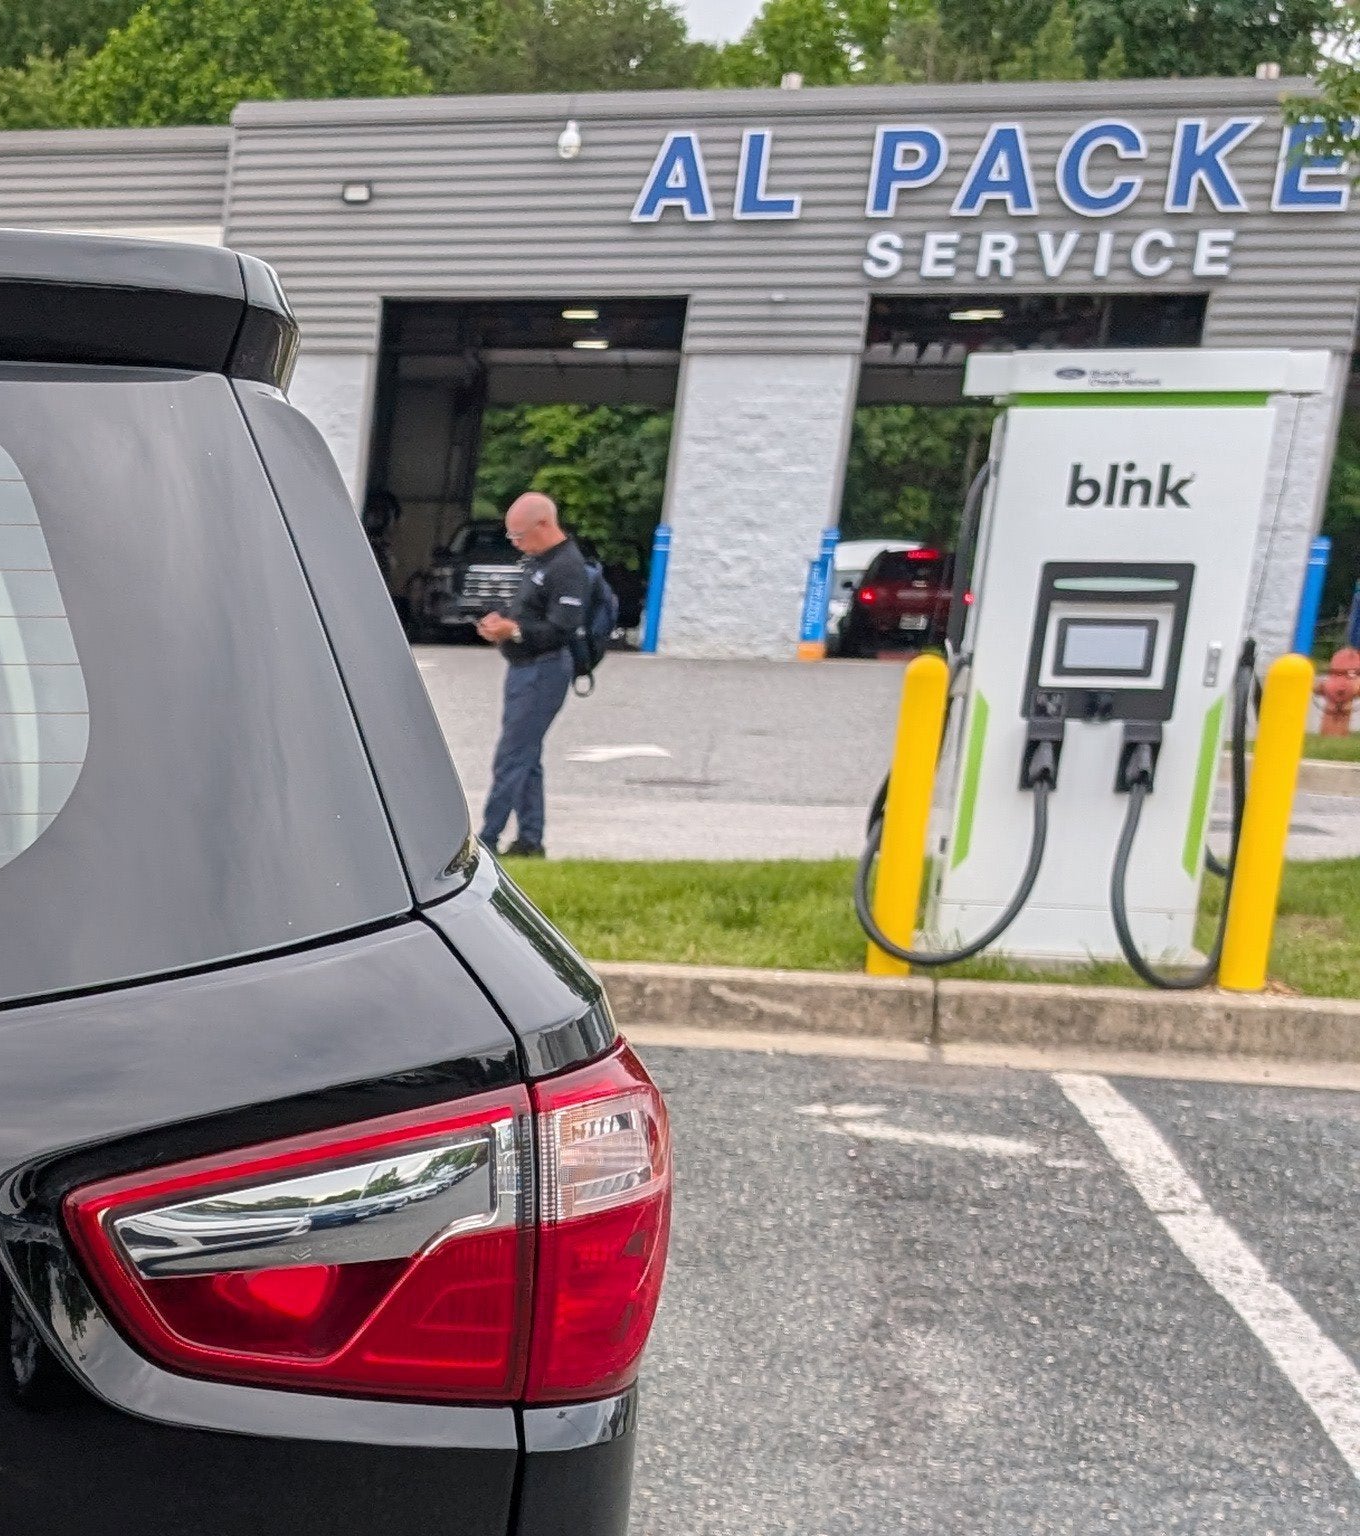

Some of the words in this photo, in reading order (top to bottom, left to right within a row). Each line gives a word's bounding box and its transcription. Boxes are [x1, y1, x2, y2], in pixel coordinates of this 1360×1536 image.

[630, 128, 802, 222] AL
[865, 115, 1360, 218] PACKE
[863, 229, 1235, 278] SERVICE
[1066, 461, 1196, 506] blink
